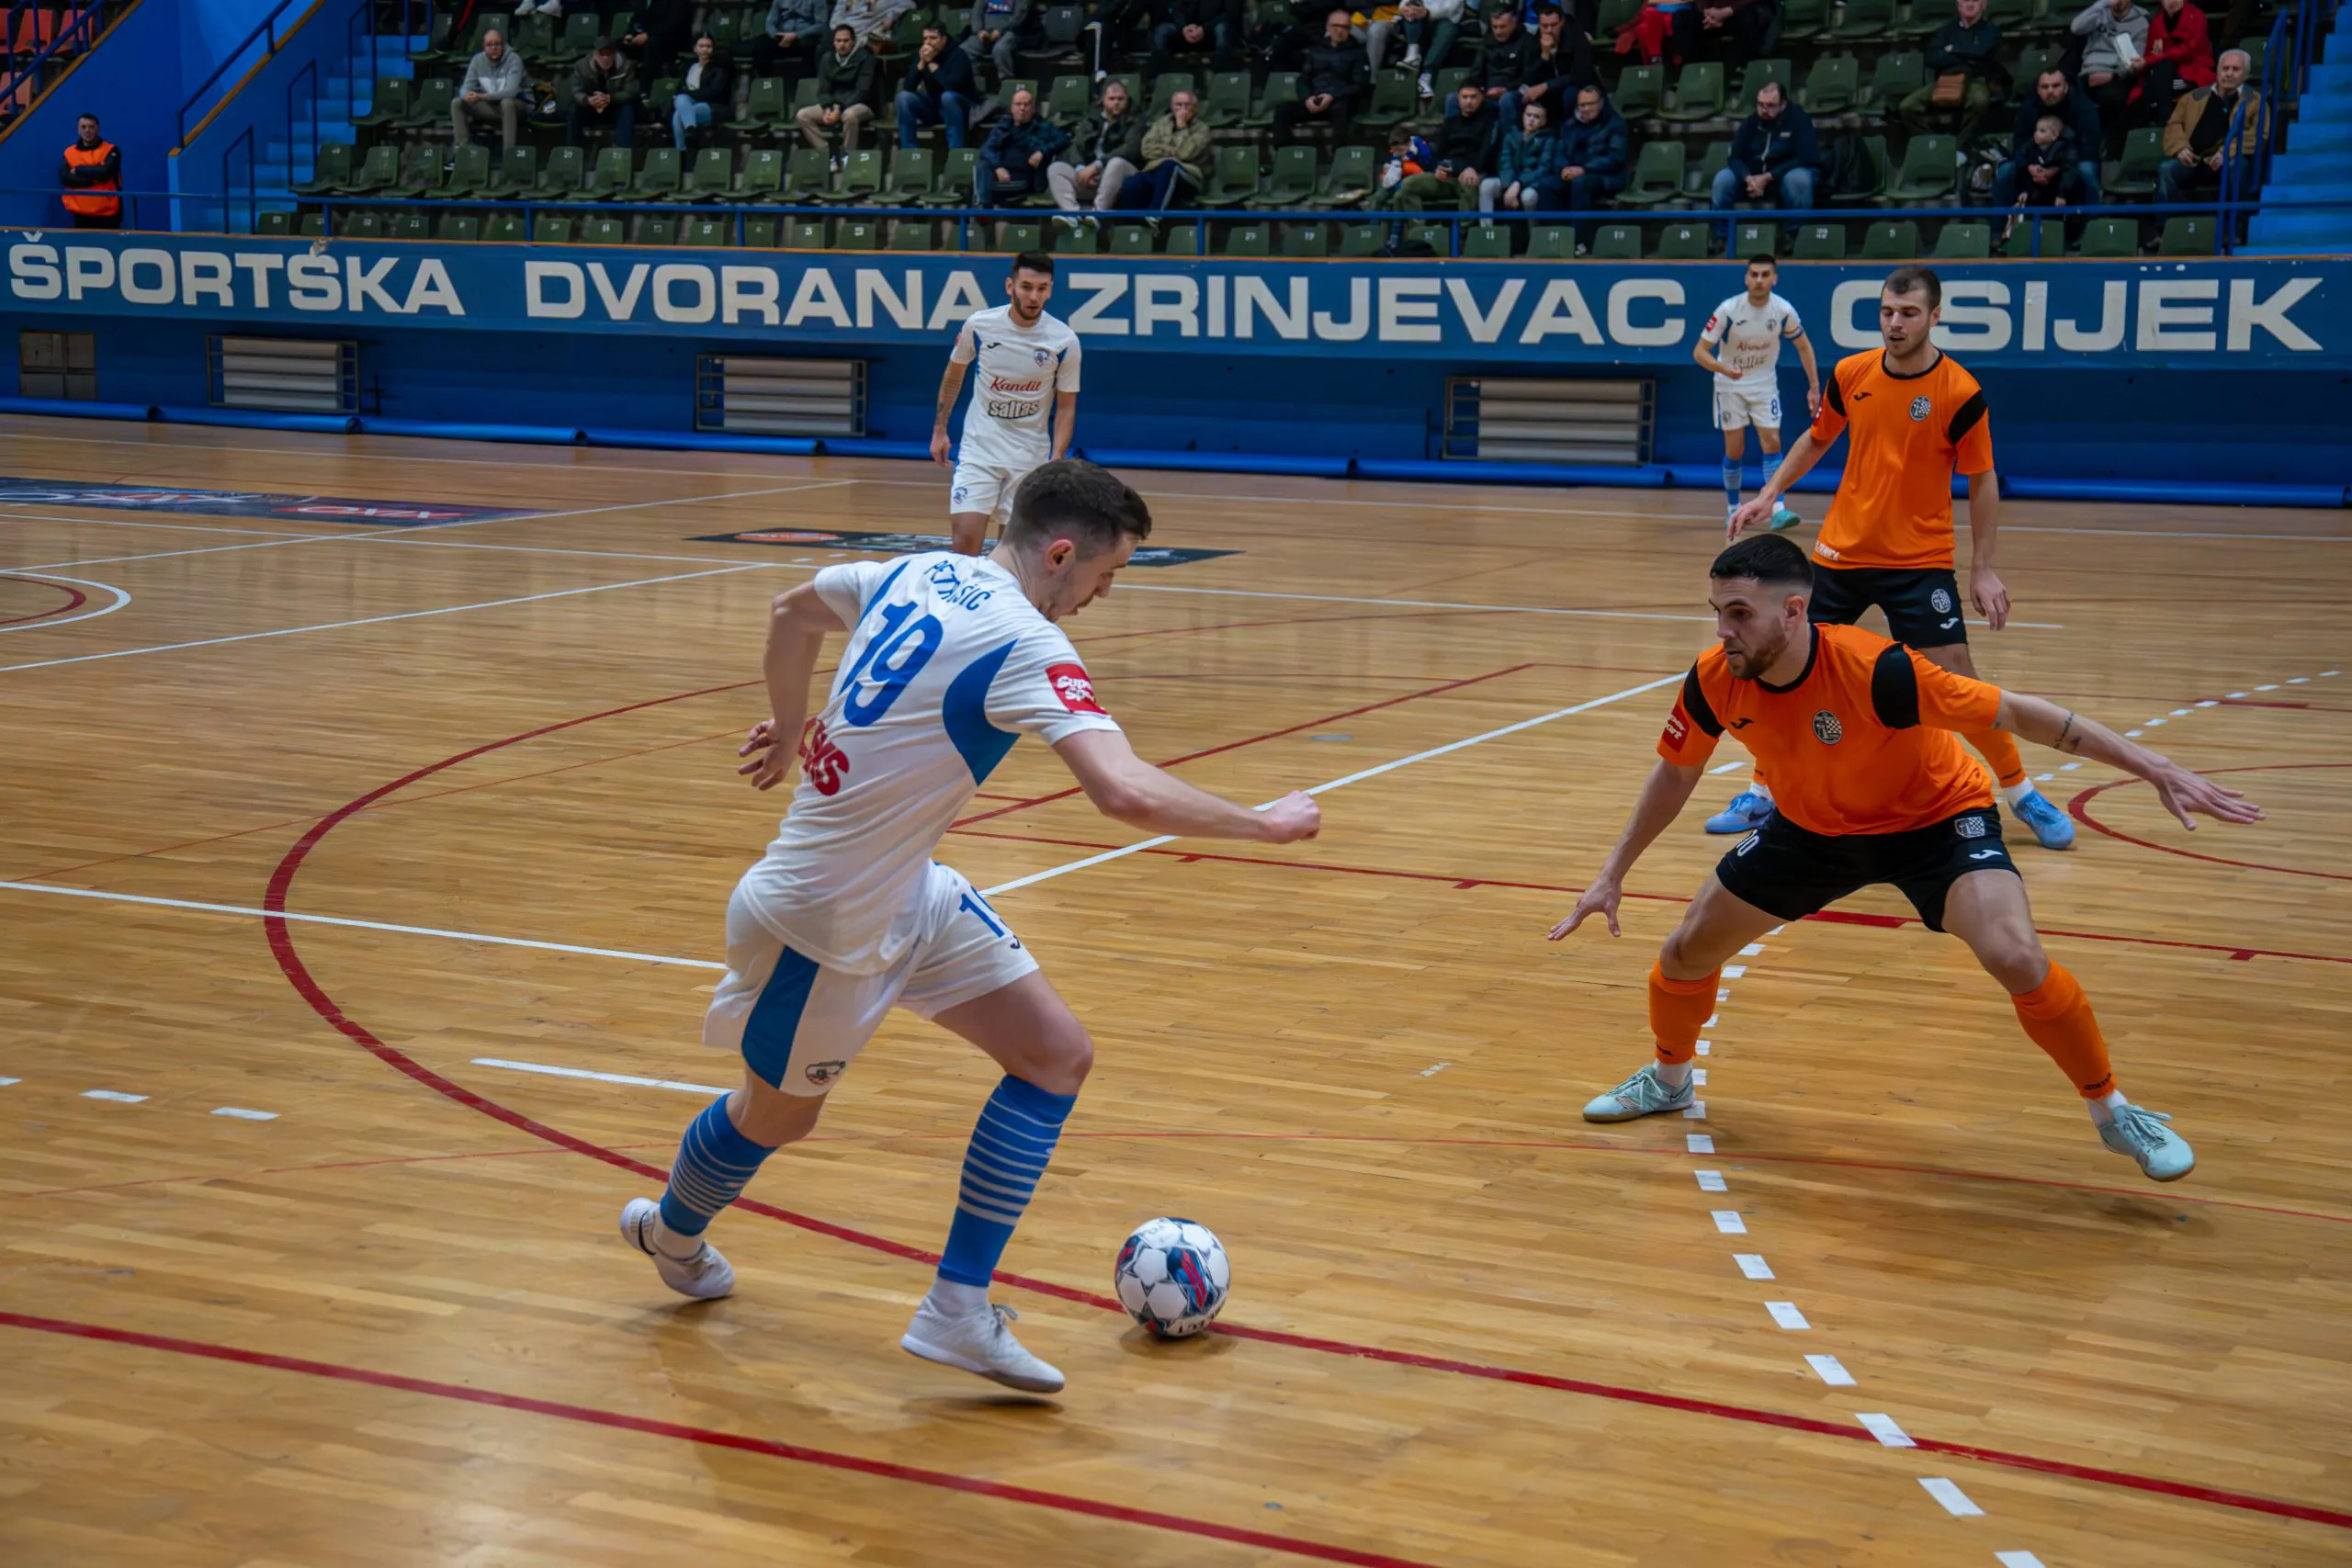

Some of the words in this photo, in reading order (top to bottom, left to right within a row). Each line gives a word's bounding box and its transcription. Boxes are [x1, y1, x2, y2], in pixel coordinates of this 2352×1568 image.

[526, 261, 988, 329] DVORANA
[1069, 273, 1685, 346] ZRINJEVAC
[1830, 277, 2323, 351] OSIJEK
[1770, 399, 1779, 415] 8
[840, 601, 943, 728] 19
[1736, 829, 1760, 857] 10
